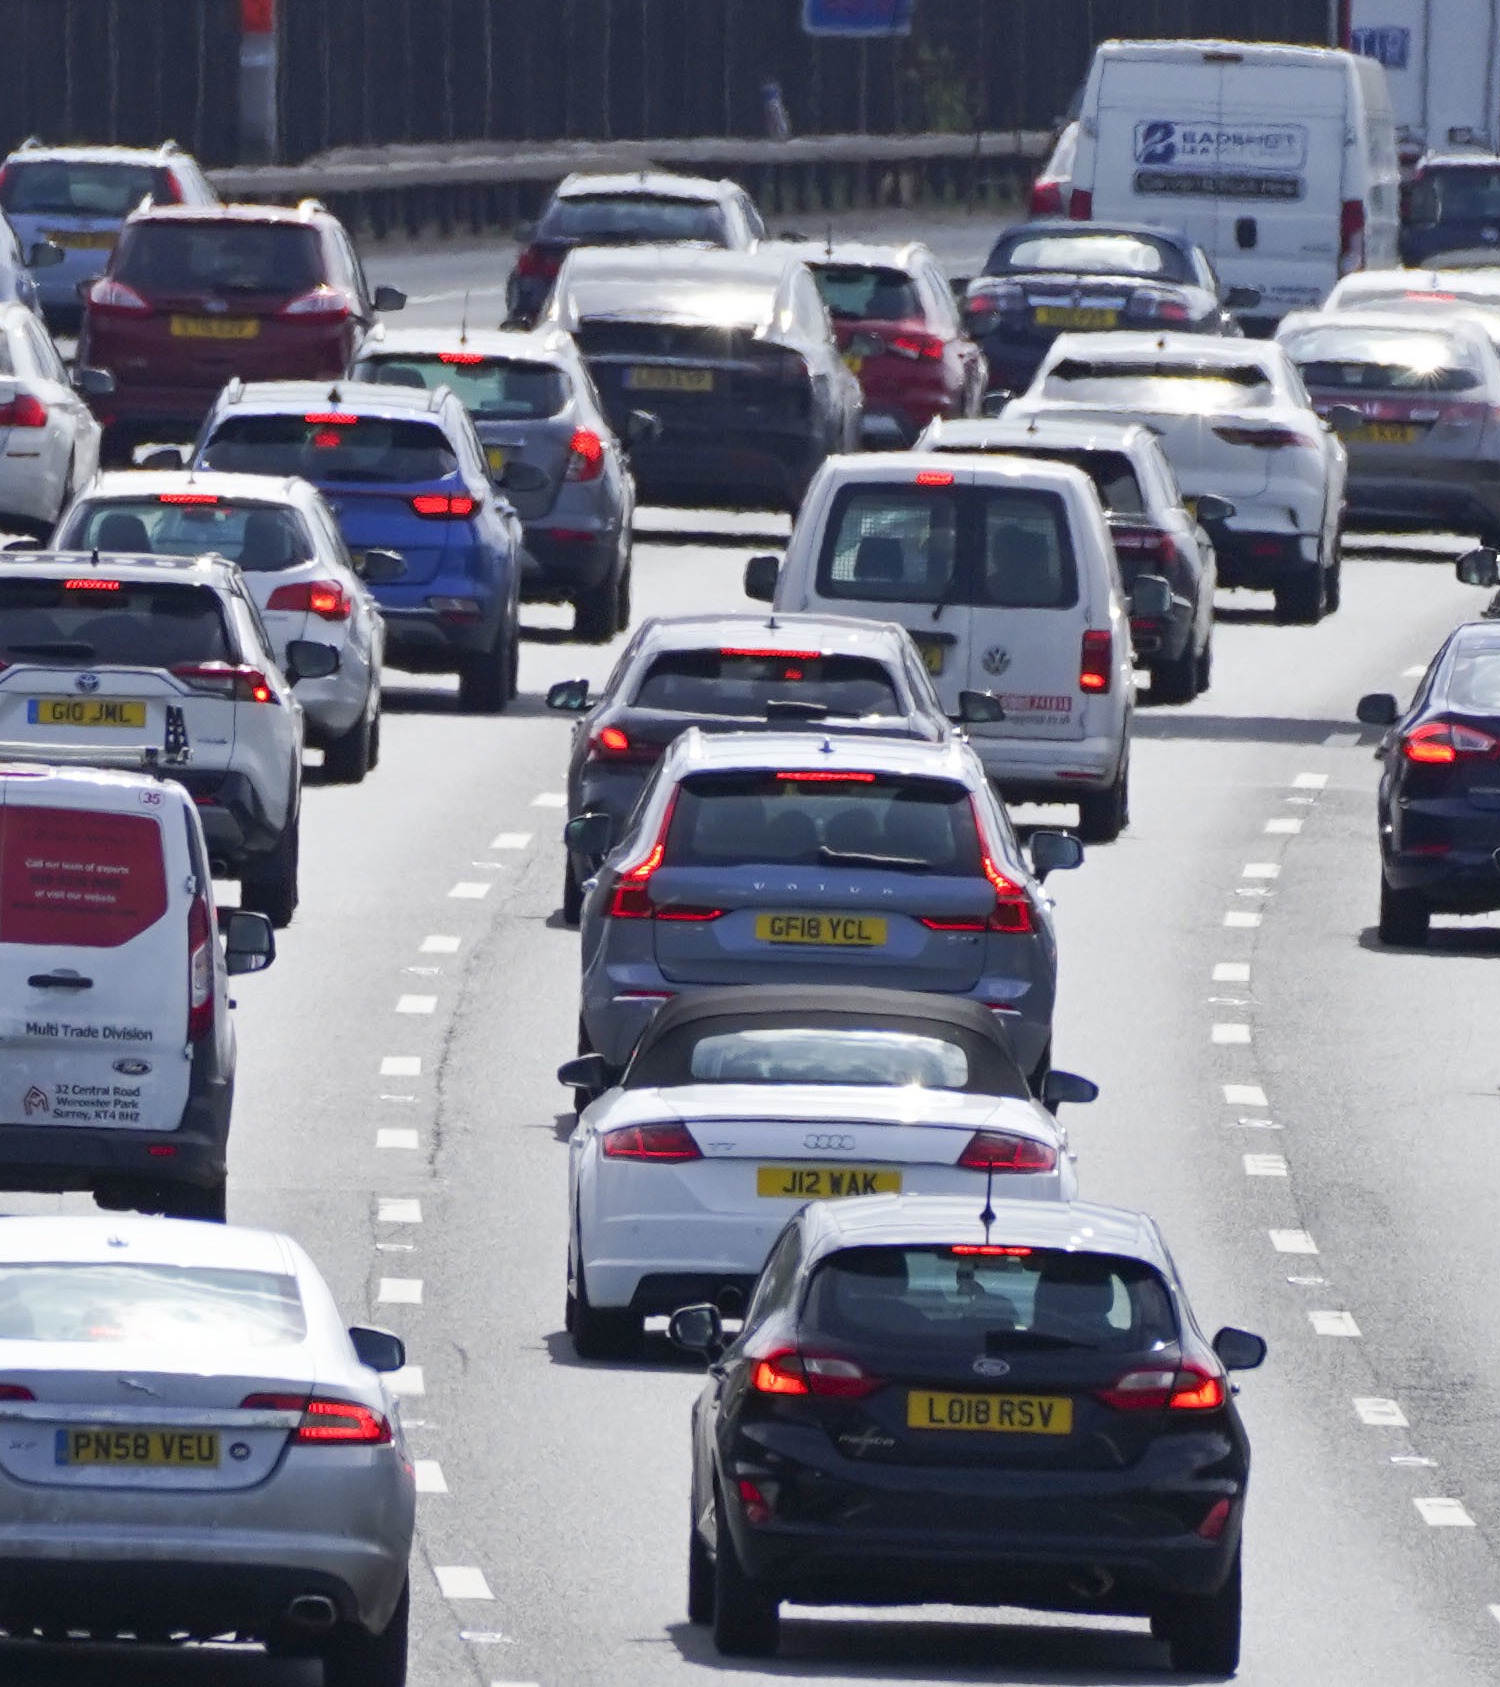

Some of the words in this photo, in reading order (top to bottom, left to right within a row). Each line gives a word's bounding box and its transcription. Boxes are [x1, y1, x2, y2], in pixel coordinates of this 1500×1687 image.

[89, 702, 130, 723] JML
[143, 792, 161, 804] 35
[96, 865, 129, 876] experts
[771, 918, 821, 937] GF18
[828, 919, 871, 940] YCL
[26, 1022, 58, 1036] Multi
[62, 1024, 99, 1038] Trade
[103, 1026, 153, 1041] Division
[55, 1084, 70, 1094] 32
[73, 1085, 110, 1096] Central
[113, 1086, 140, 1097] Road
[56, 1097, 112, 1109] Worcester
[114, 1098, 139, 1110] Park
[53, 1108, 91, 1122] Surrey,
[783, 1172, 818, 1193] J12
[829, 1172, 878, 1195] WAK
[929, 1400, 989, 1425] LO18
[998, 1401, 1055, 1428] RSV
[75, 1435, 149, 1460] PN58
[158, 1437, 215, 1462] VEU
